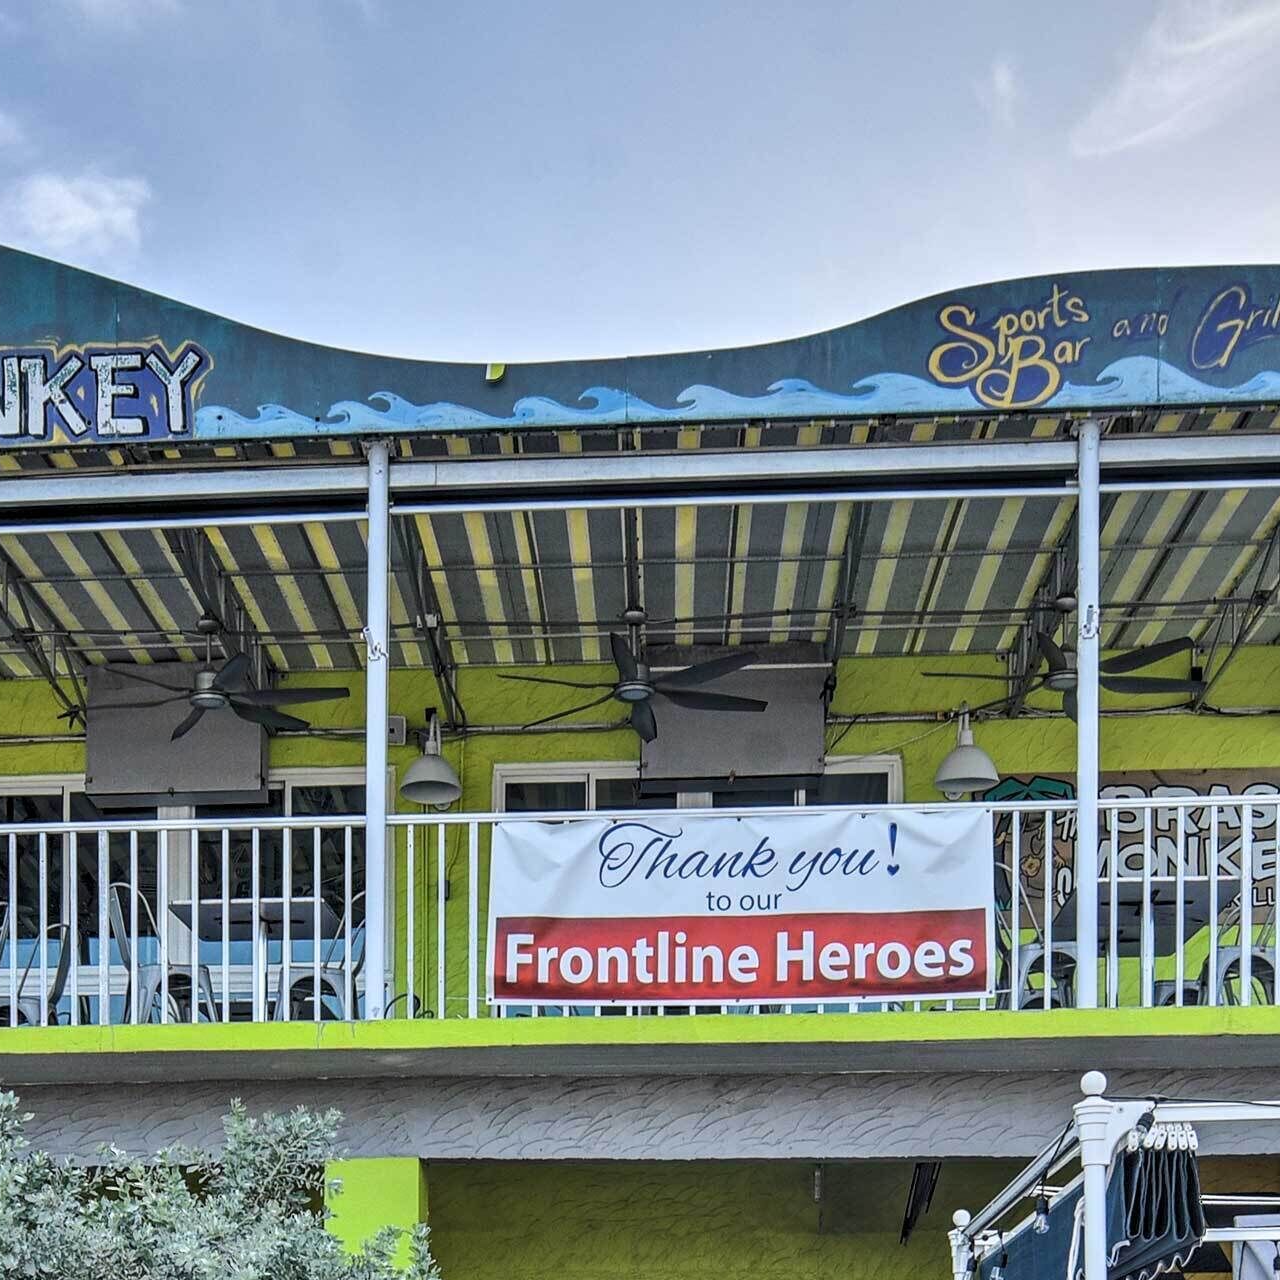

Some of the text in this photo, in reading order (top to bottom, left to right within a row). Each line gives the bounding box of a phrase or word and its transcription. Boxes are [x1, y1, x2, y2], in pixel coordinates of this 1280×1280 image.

[927, 283, 1091, 384] Sports
[1112, 309, 1170, 339] and
[975, 335, 1092, 408] Bar
[598, 822, 778, 889] Thank
[705, 891, 783, 912] to our
[505, 930, 975, 985] Frontline Heroes
